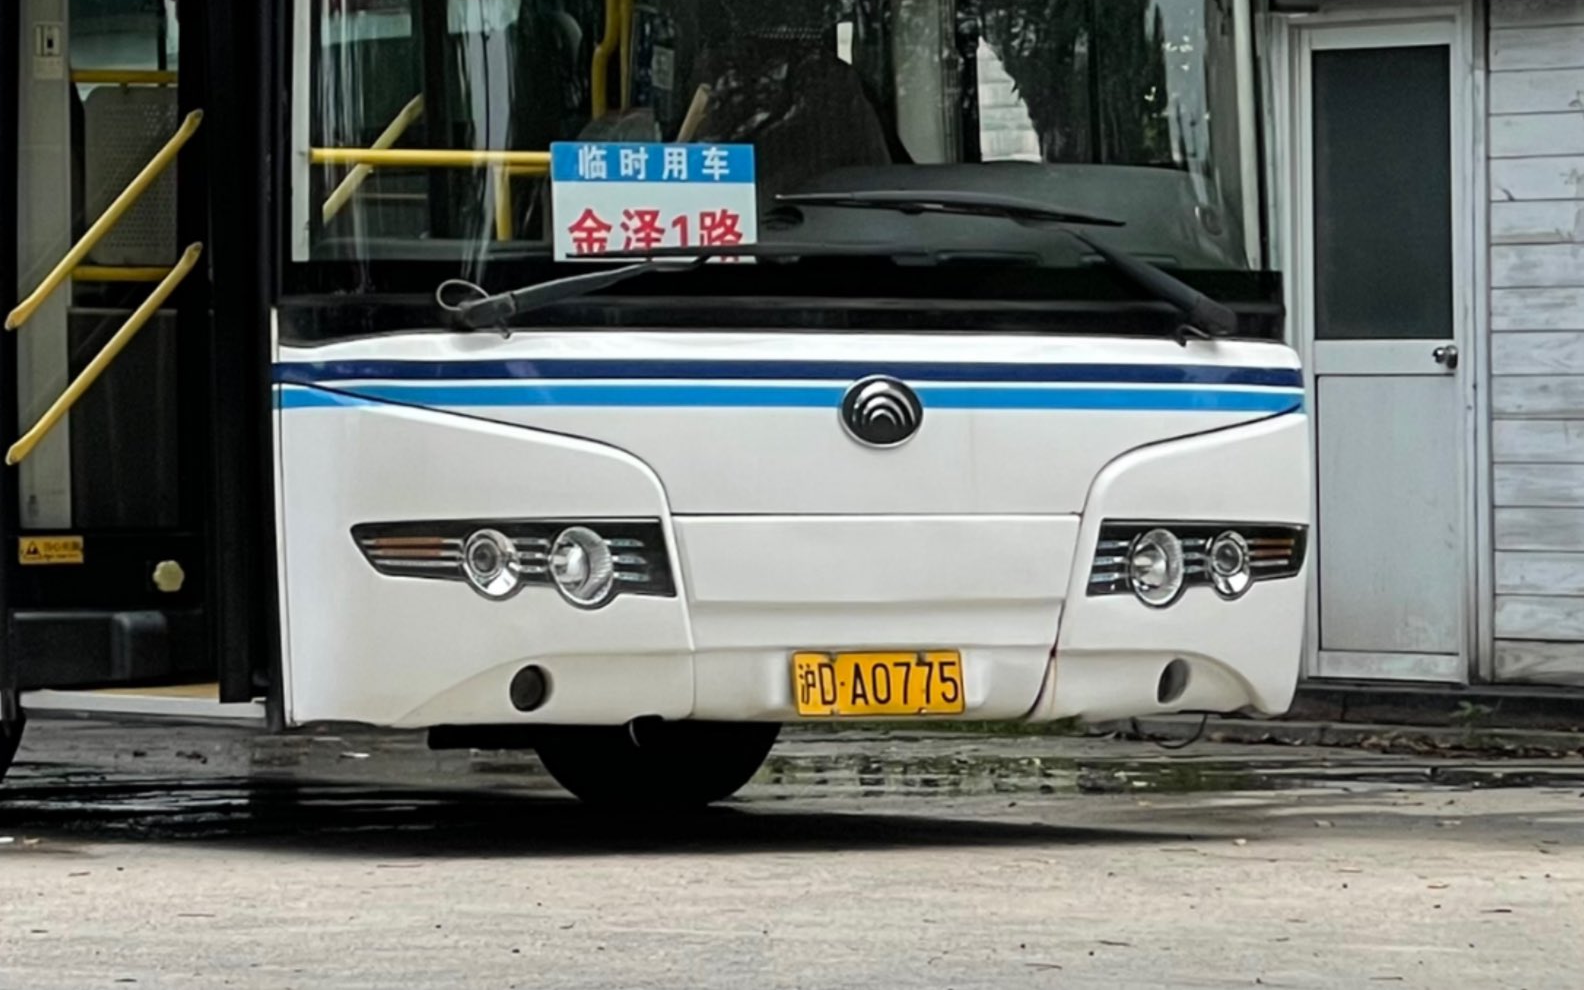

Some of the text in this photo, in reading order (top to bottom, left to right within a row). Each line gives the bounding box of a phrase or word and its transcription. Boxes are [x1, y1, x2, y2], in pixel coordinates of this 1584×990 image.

[578, 145, 731, 181] 临时用车
[568, 208, 743, 261] 金泽1路
